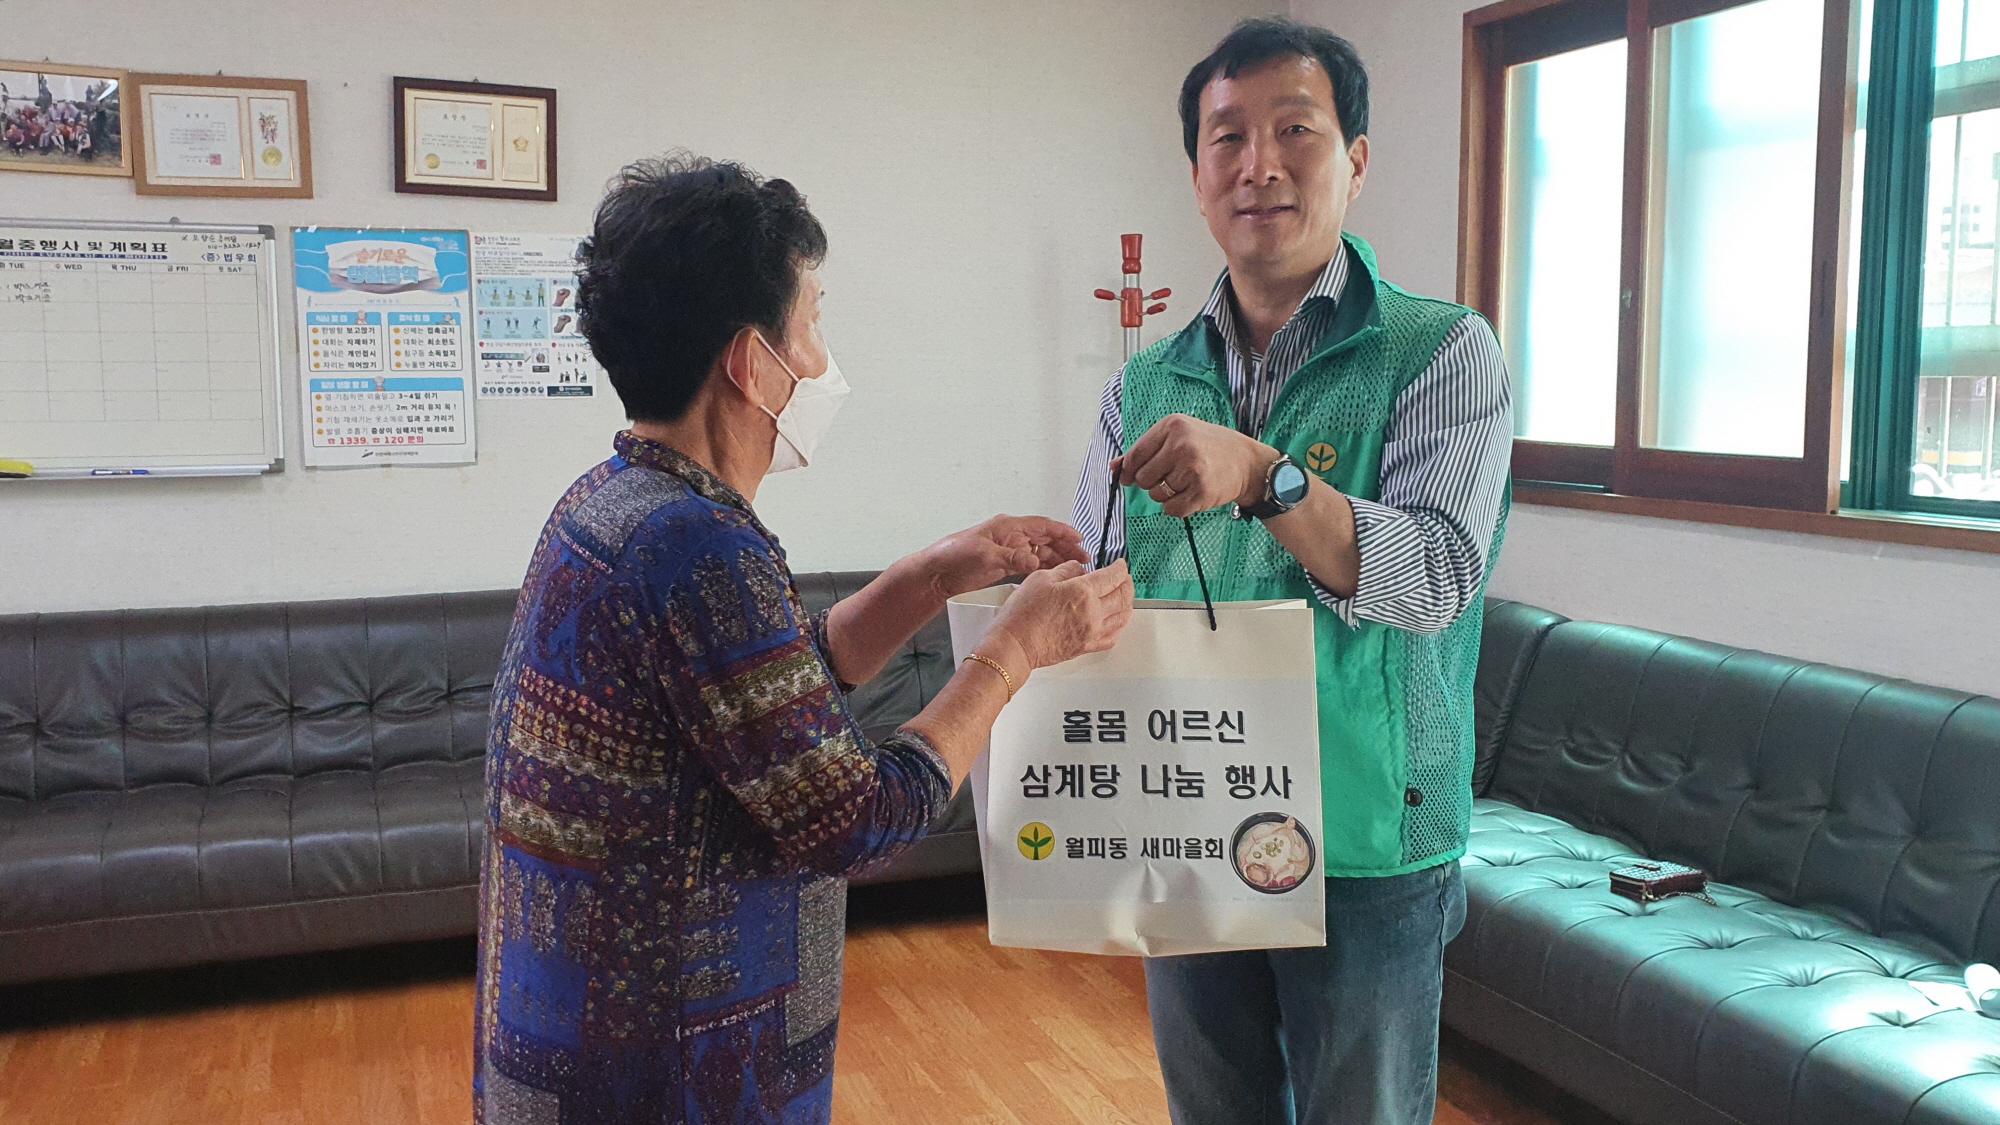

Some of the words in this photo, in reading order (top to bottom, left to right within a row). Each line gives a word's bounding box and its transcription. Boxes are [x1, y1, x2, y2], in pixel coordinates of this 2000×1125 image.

[88, 241, 103, 251] 및
[109, 242, 168, 253] 계획표
[403, 338, 424, 346] 대화는
[424, 392, 438, 400] 쉬기
[385, 436, 404, 444] 120
[1063, 709, 1127, 743] 홀몸
[1148, 709, 1246, 744] 어르신
[1019, 764, 1121, 798] 삼계탕
[1141, 764, 1205, 798] 나눔
[1224, 764, 1292, 799] 행사
[1065, 837, 1128, 860] 월피동
[1140, 837, 1224, 860] 새마을회
